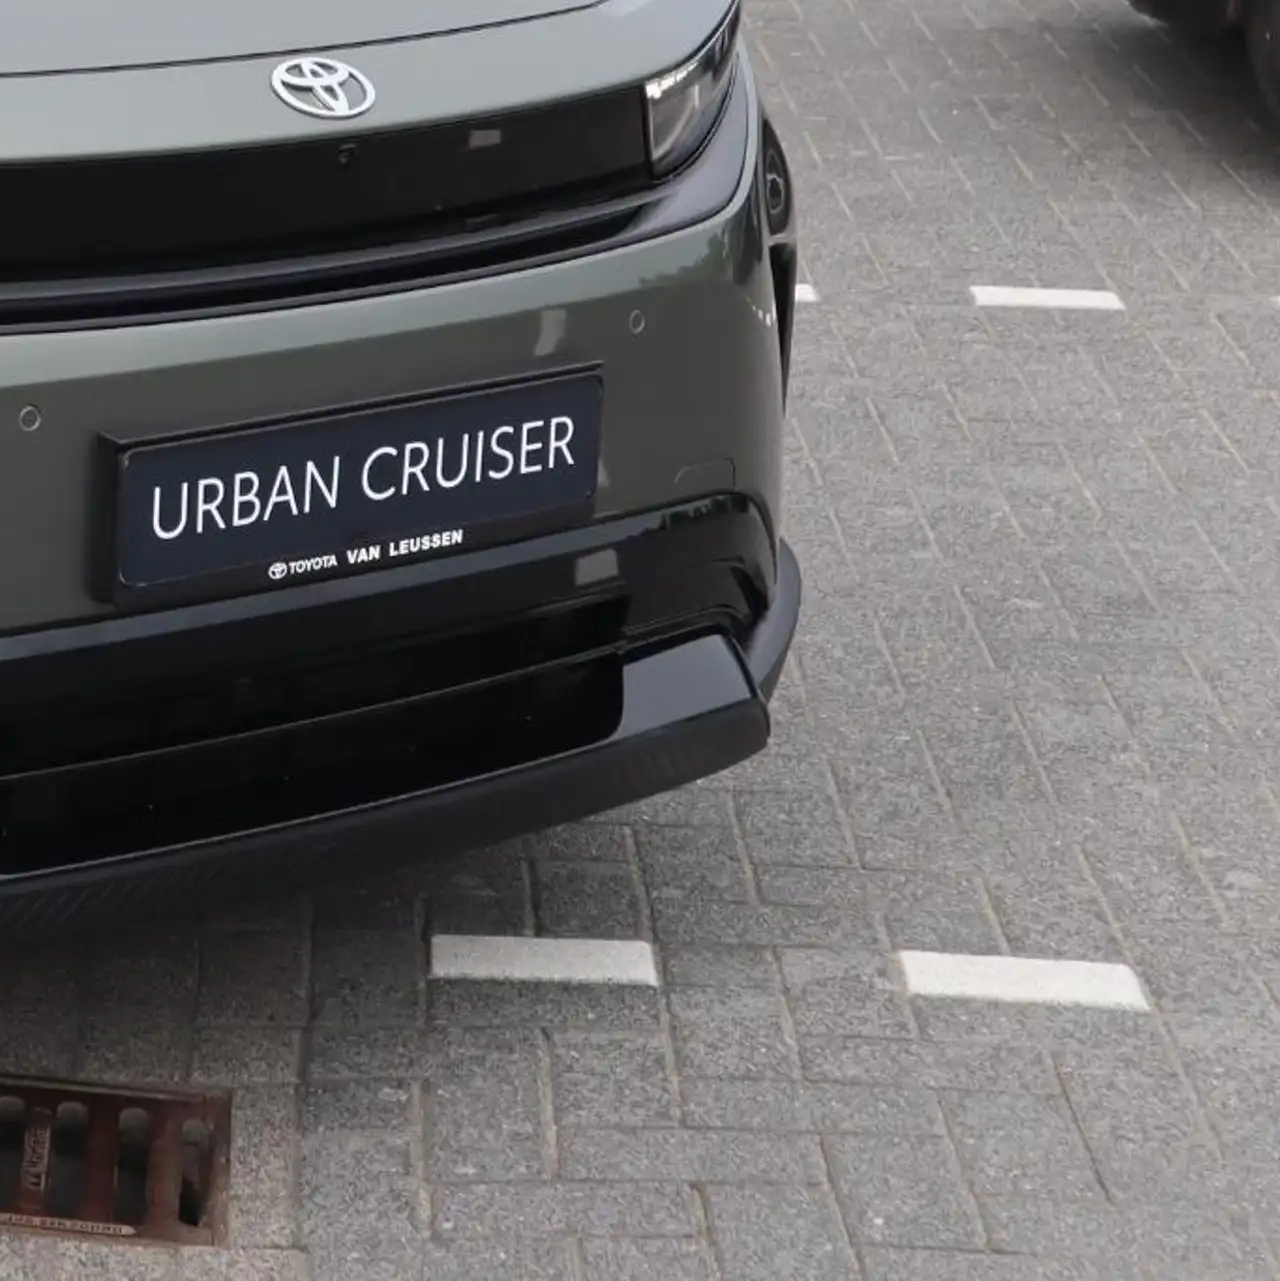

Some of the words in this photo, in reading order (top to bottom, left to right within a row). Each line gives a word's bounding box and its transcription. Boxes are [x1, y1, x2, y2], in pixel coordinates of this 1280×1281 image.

[152, 455, 341, 540] URBAN
[361, 416, 576, 501] CRUISER
[288, 555, 338, 575] TOYOTA
[346, 545, 381, 565] VAN
[389, 529, 464, 556] LEUSSEN
